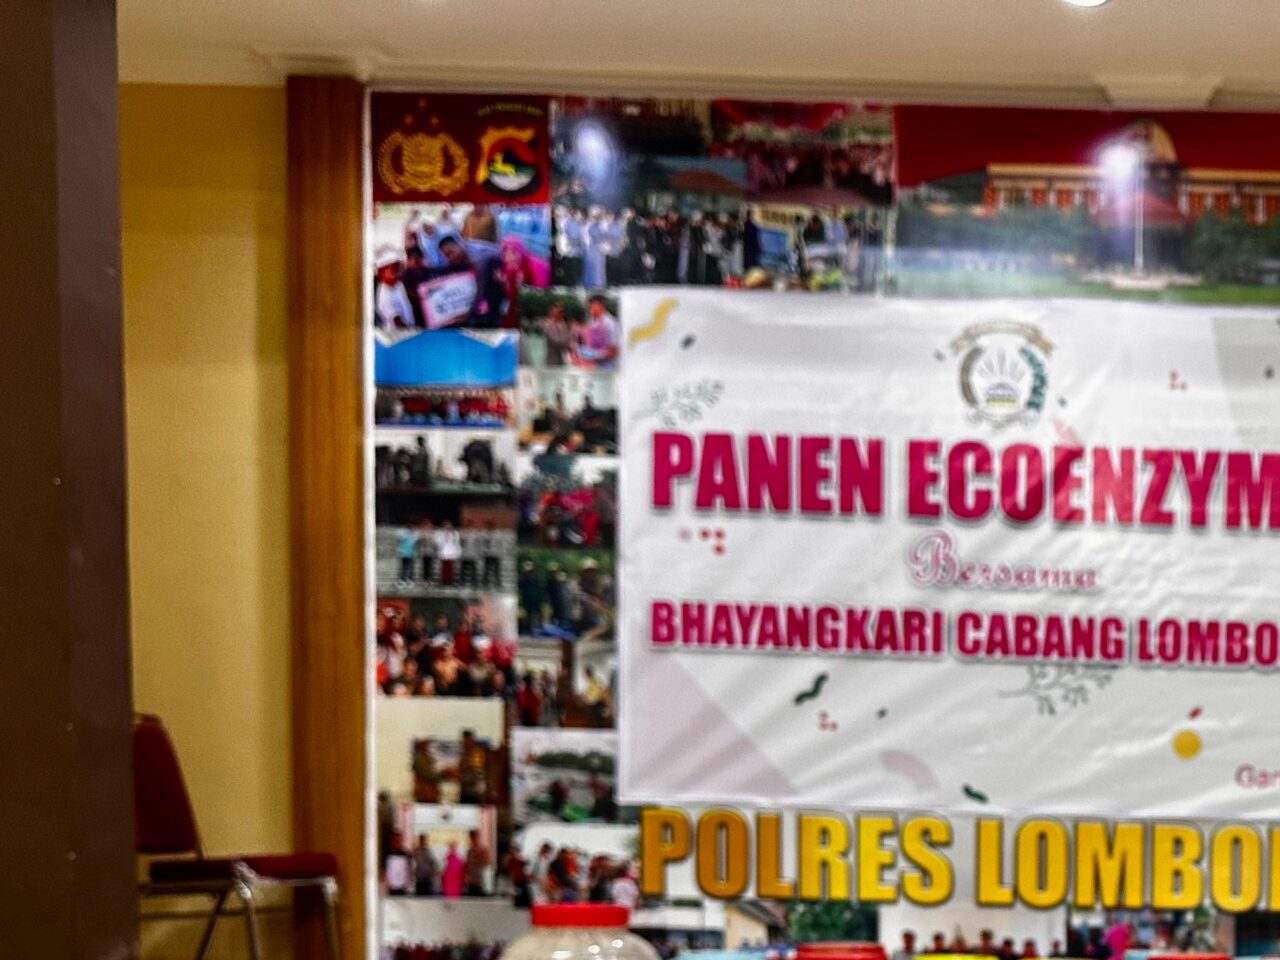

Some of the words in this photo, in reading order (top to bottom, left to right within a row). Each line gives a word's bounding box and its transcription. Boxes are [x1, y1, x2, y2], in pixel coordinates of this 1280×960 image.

[652, 432, 883, 516] PANEN
[909, 531, 1097, 588] Bersama
[651, 601, 943, 654] BHAYANGKARI
[956, 611, 1126, 662] CABANG
[641, 806, 953, 907] POLRES
